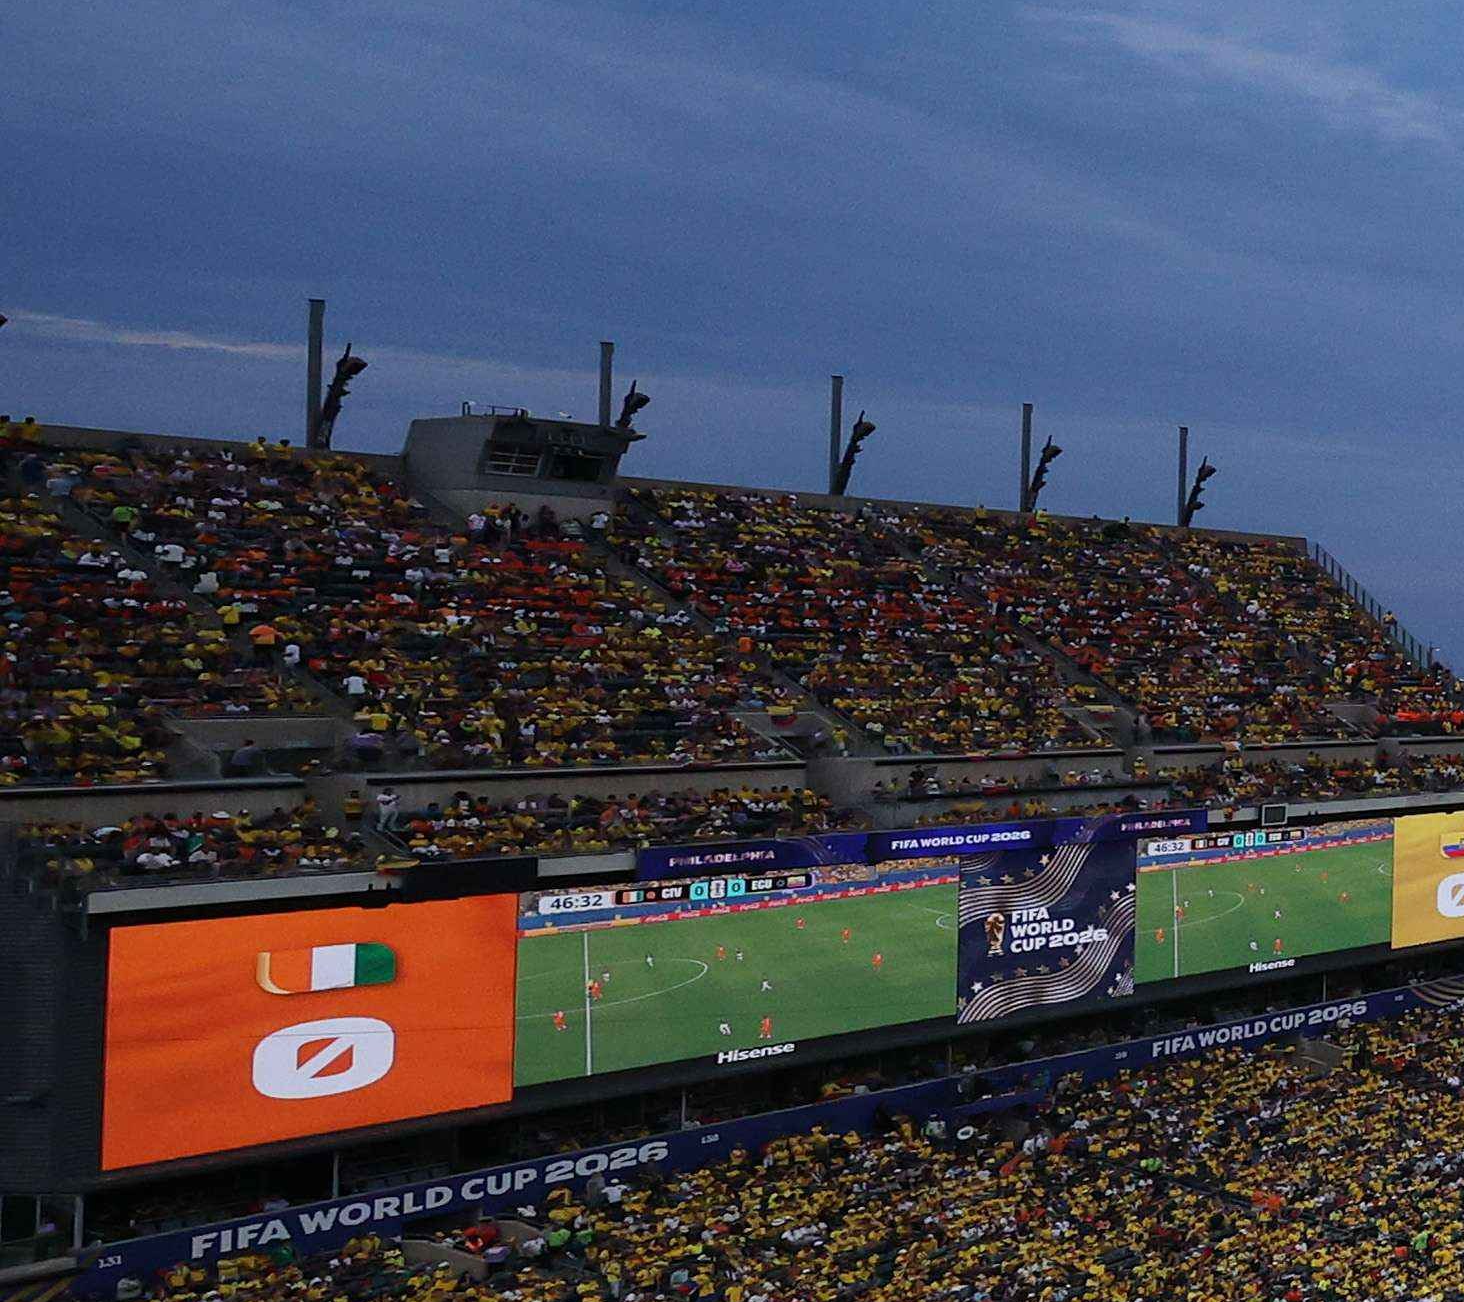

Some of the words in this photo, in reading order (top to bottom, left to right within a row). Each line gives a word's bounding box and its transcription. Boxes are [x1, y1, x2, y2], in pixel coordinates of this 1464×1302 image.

[891, 839, 918, 850] FIFA
[921, 836, 964, 848] WORLD
[966, 833, 990, 845] CUP
[990, 830, 1031, 842] 2026
[669, 850, 775, 868] PHILADELPHIA
[550, 894, 603, 911] 46:32
[1011, 907, 1049, 924] FIFA
[1010, 919, 1075, 938] WORLD
[1010, 936, 1046, 954] CUP
[1049, 927, 1109, 948] 2026
[1249, 958, 1295, 974] Hisense
[1151, 1035, 1196, 1058] FIFA
[1199, 1020, 1267, 1048] WORLD
[1270, 1014, 1305, 1033] CUP
[1308, 1000, 1368, 1026] 2026
[717, 1043, 795, 1065] Hisense
[191, 1219, 290, 1259] FIFA
[300, 1185, 453, 1234] WORLD
[461, 1168, 537, 1200] CUP
[545, 1141, 668, 1184] 2026
